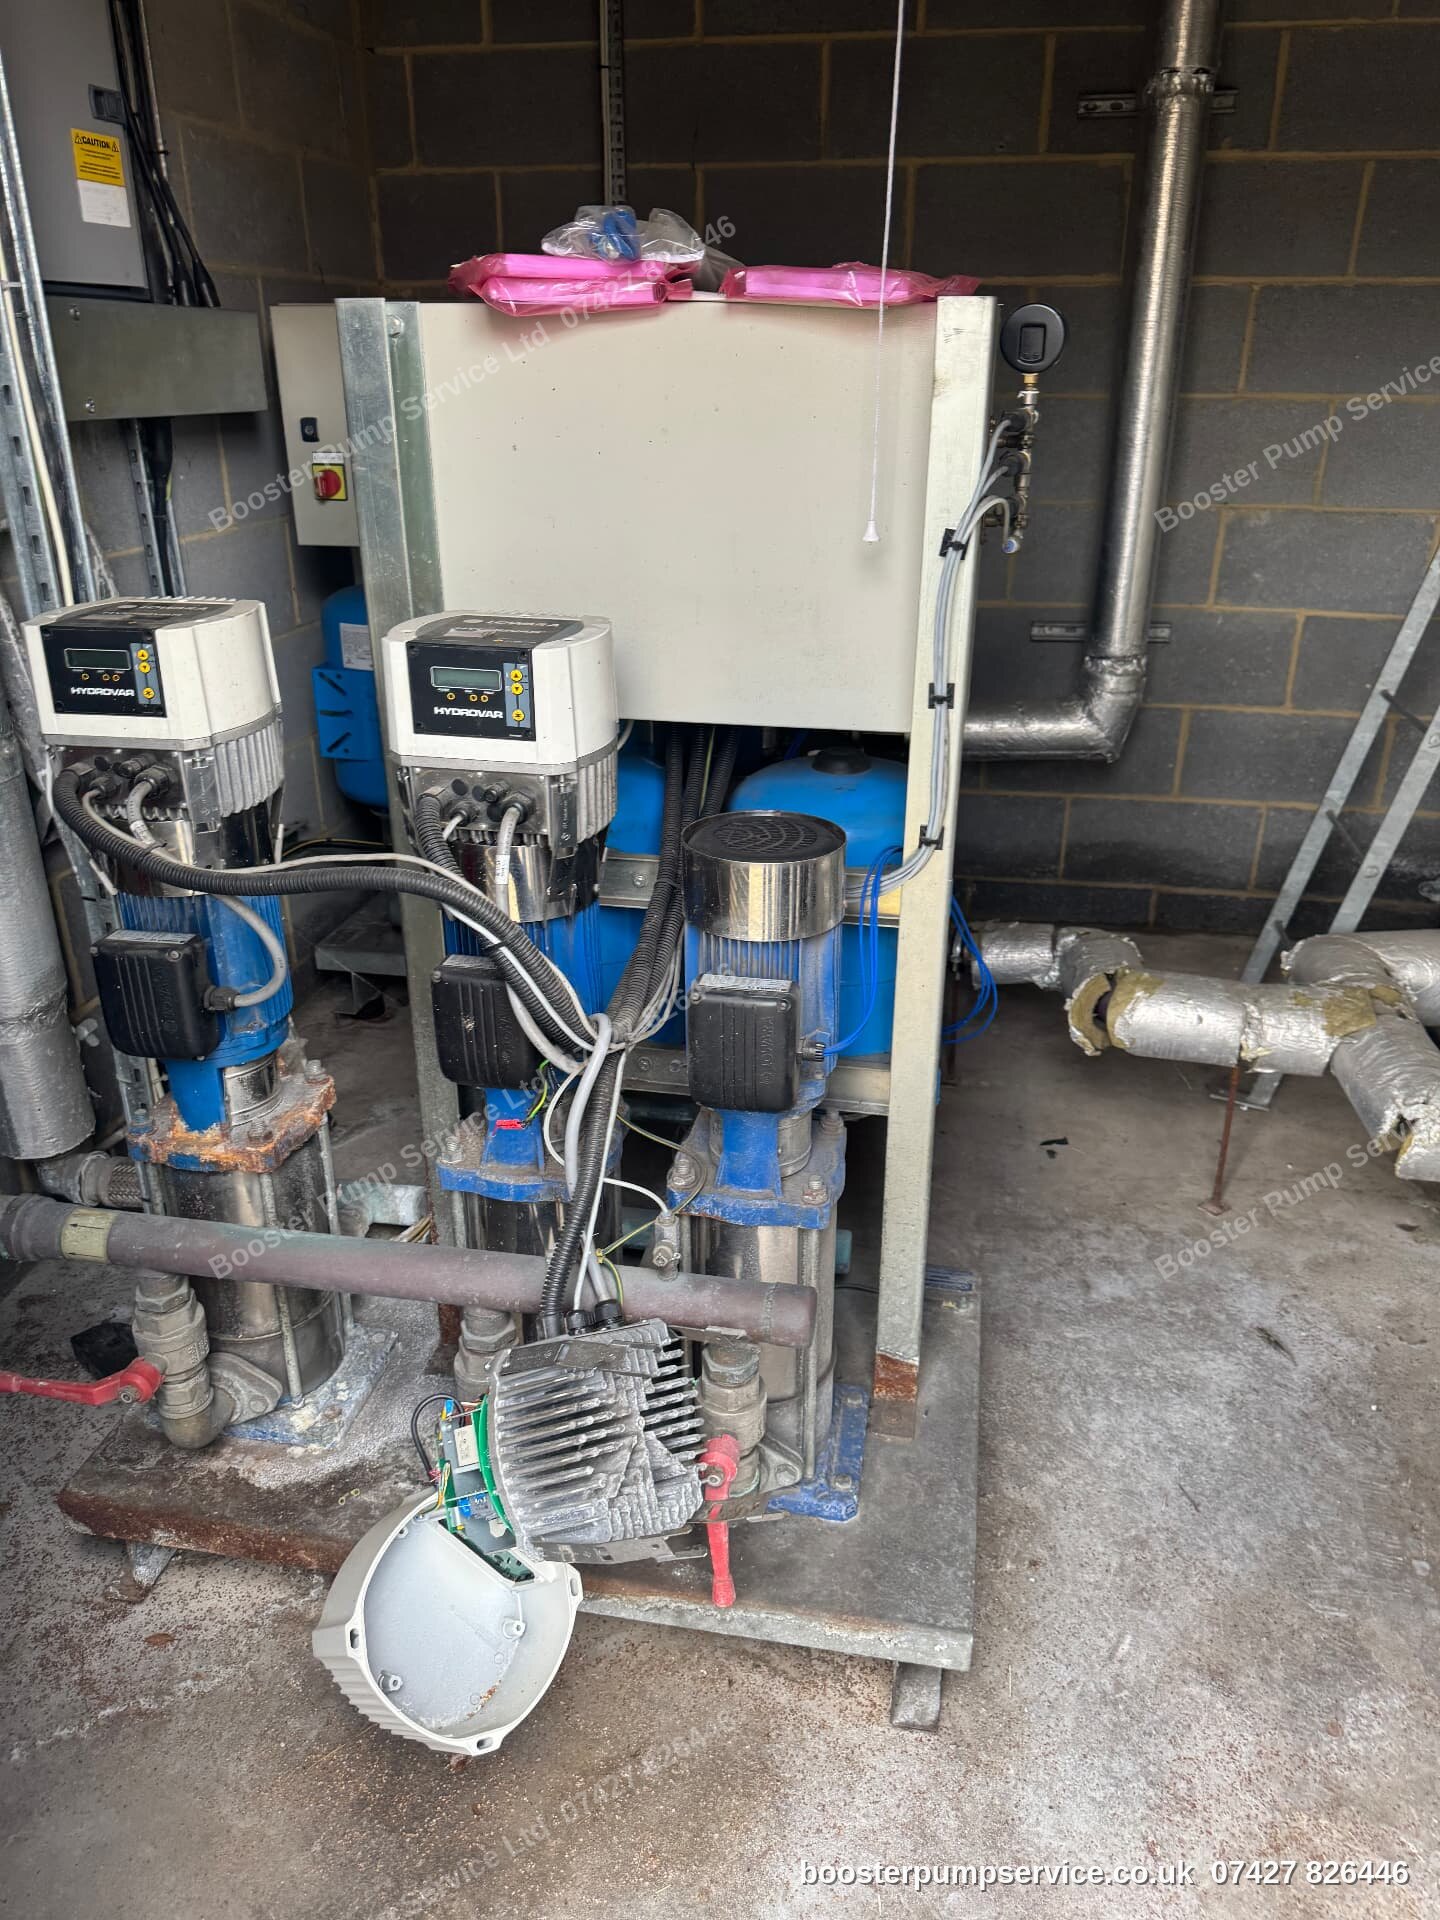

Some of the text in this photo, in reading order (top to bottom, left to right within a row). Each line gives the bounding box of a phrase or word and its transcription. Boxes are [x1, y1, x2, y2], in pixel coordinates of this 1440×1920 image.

[82, 135, 111, 149] CAUTION
[71, 686, 135, 698] HYDROVAR
[433, 706, 504, 719] HYDROVAR
